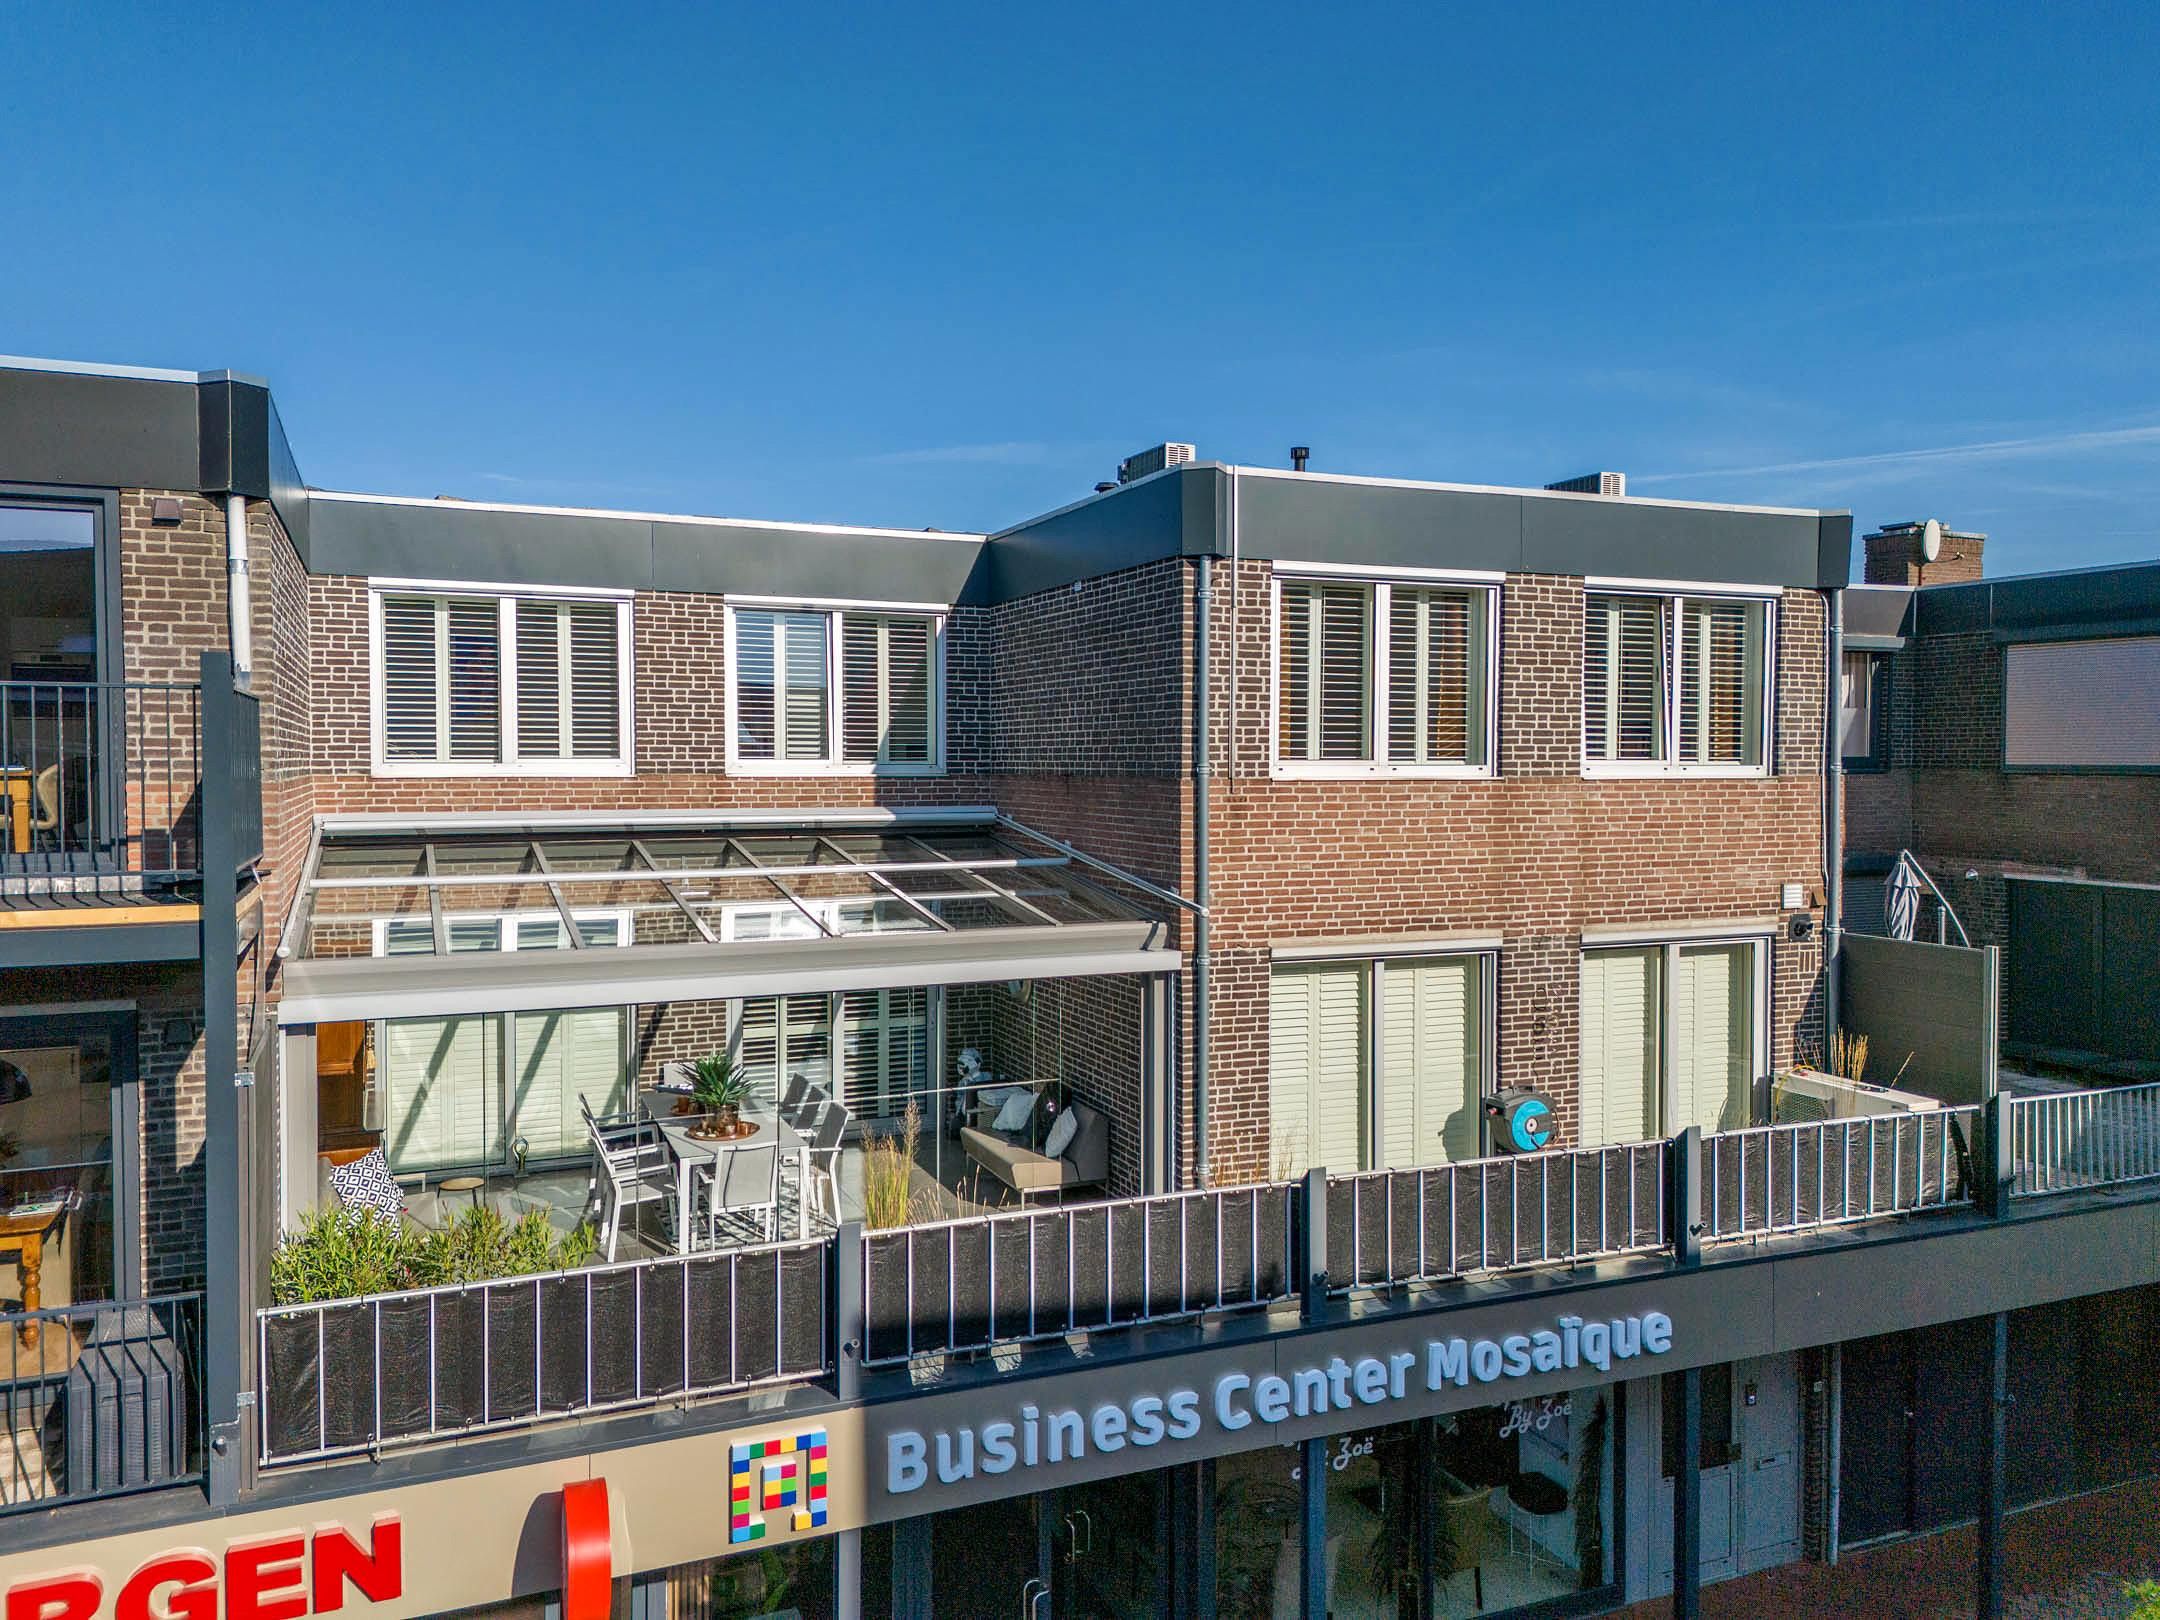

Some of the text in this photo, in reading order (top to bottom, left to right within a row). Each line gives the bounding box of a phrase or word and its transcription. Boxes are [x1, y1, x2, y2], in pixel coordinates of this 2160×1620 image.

[887, 1391, 1202, 1494] Business
[1214, 1352, 1416, 1431] Center
[1426, 1311, 1673, 1392] Mosaïque
